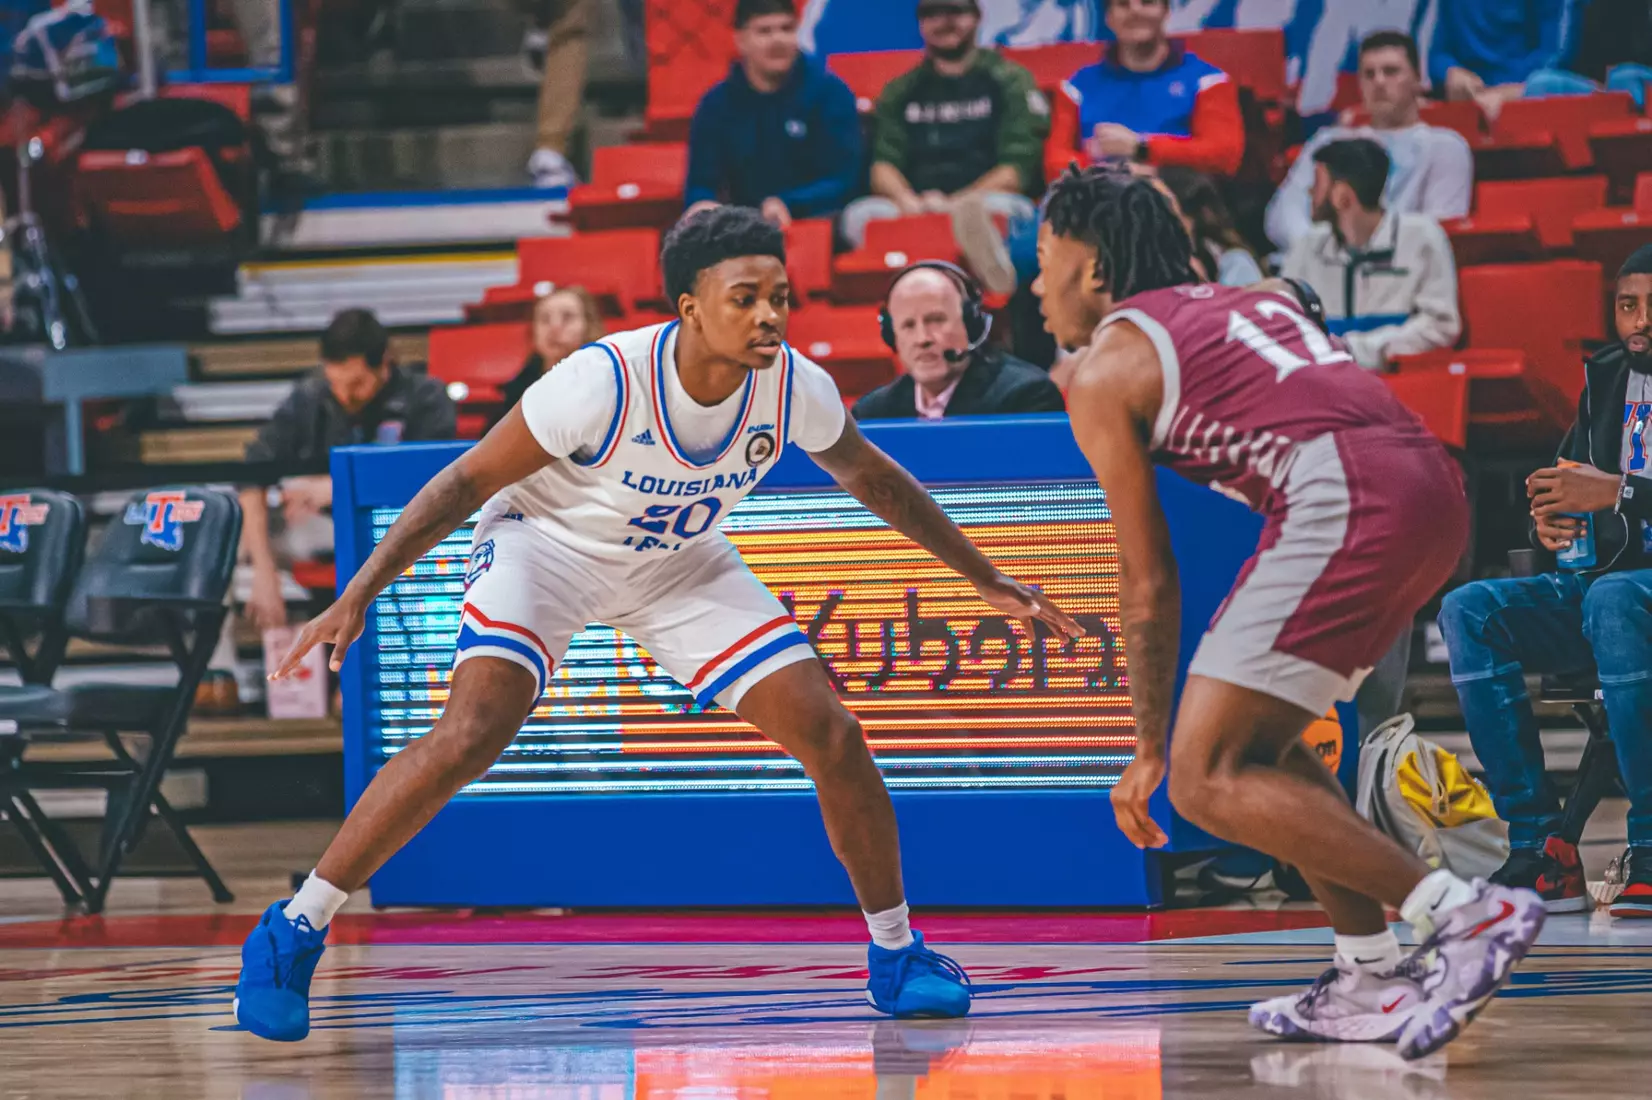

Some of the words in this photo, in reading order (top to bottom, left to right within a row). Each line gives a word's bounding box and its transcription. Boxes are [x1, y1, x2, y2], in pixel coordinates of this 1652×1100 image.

[1225, 299, 1353, 384] 12
[621, 468, 757, 497] LOUISIANA
[627, 497, 722, 540] 20
